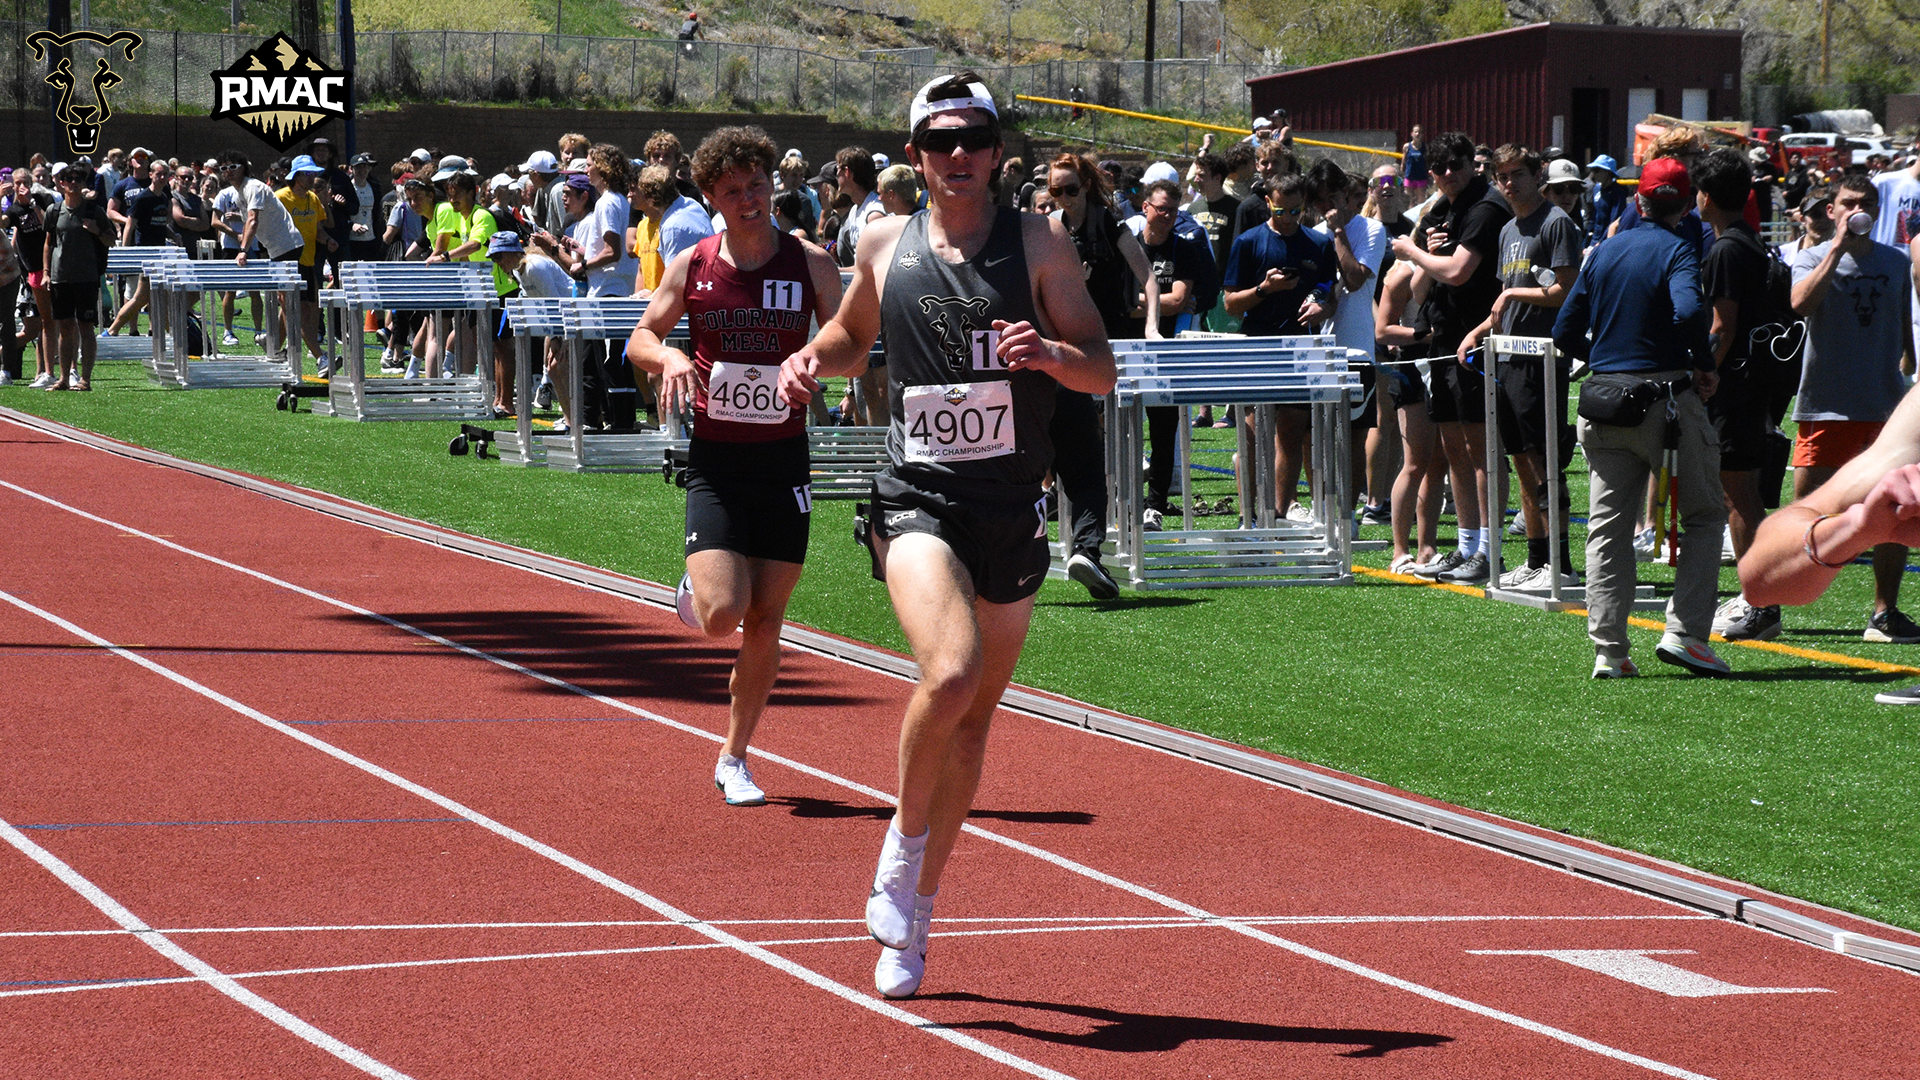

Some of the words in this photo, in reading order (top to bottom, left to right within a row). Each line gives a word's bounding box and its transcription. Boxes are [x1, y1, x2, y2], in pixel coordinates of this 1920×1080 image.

[767, 281, 793, 309] 11
[696, 308, 808, 332] COLORADO
[721, 332, 781, 352] MESA
[1512, 339, 1538, 354] MINES
[715, 409, 734, 417] RMAC
[735, 412, 783, 420] CHAMPIONSHIP
[909, 404, 1008, 446] 4907
[916, 449, 941, 457] RMAC
[942, 443, 1005, 456] CHAMPIONSHIP
[888, 510, 917, 526] UCCS
